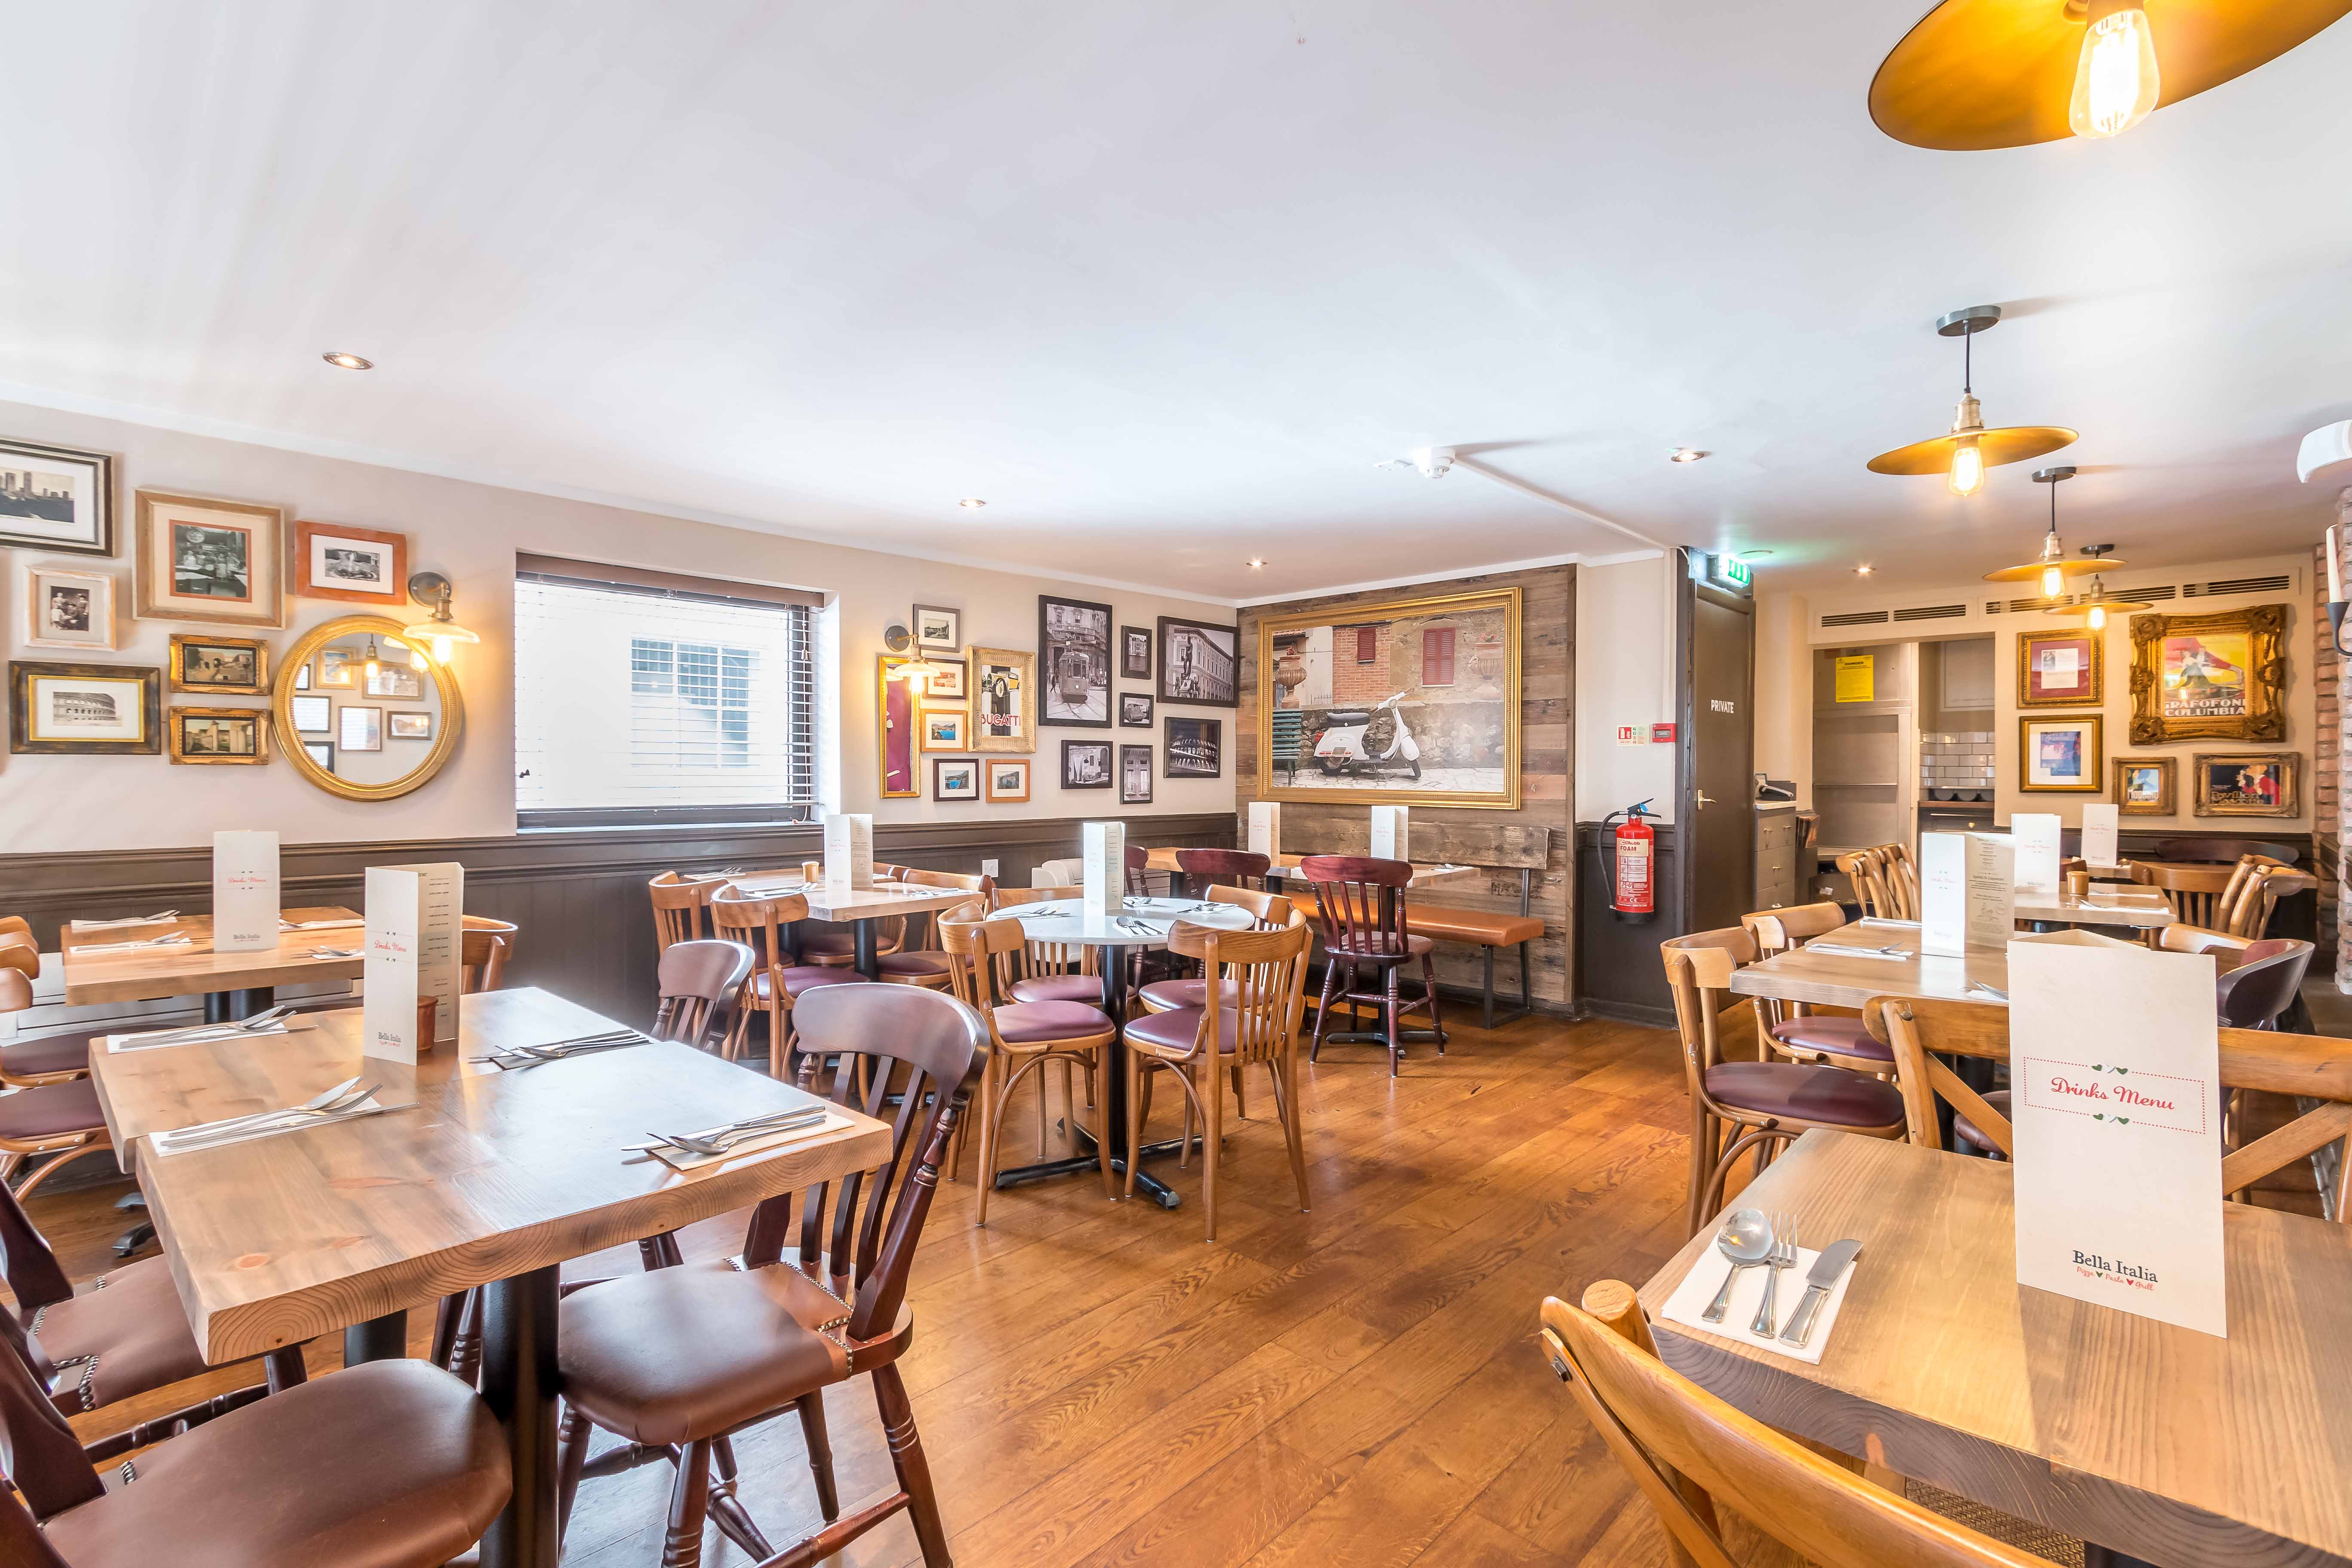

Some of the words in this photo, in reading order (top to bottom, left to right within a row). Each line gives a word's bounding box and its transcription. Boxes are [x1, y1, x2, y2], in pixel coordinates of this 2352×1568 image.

[1711, 699, 1734, 714] PRIVATE
[2165, 707, 2246, 717] COLUMBIA
[981, 713, 1021, 726] BUGATTI
[2051, 1077, 2109, 1099] Drinks
[2113, 1086, 2175, 1110] Menu
[2072, 1250, 2112, 1271] Bella
[2115, 1260, 2158, 1283] Italia
[2076, 1266, 2095, 1277] Pizza
[2105, 1273, 2125, 1283] Pasta
[2135, 1281, 2154, 1291] Grill
